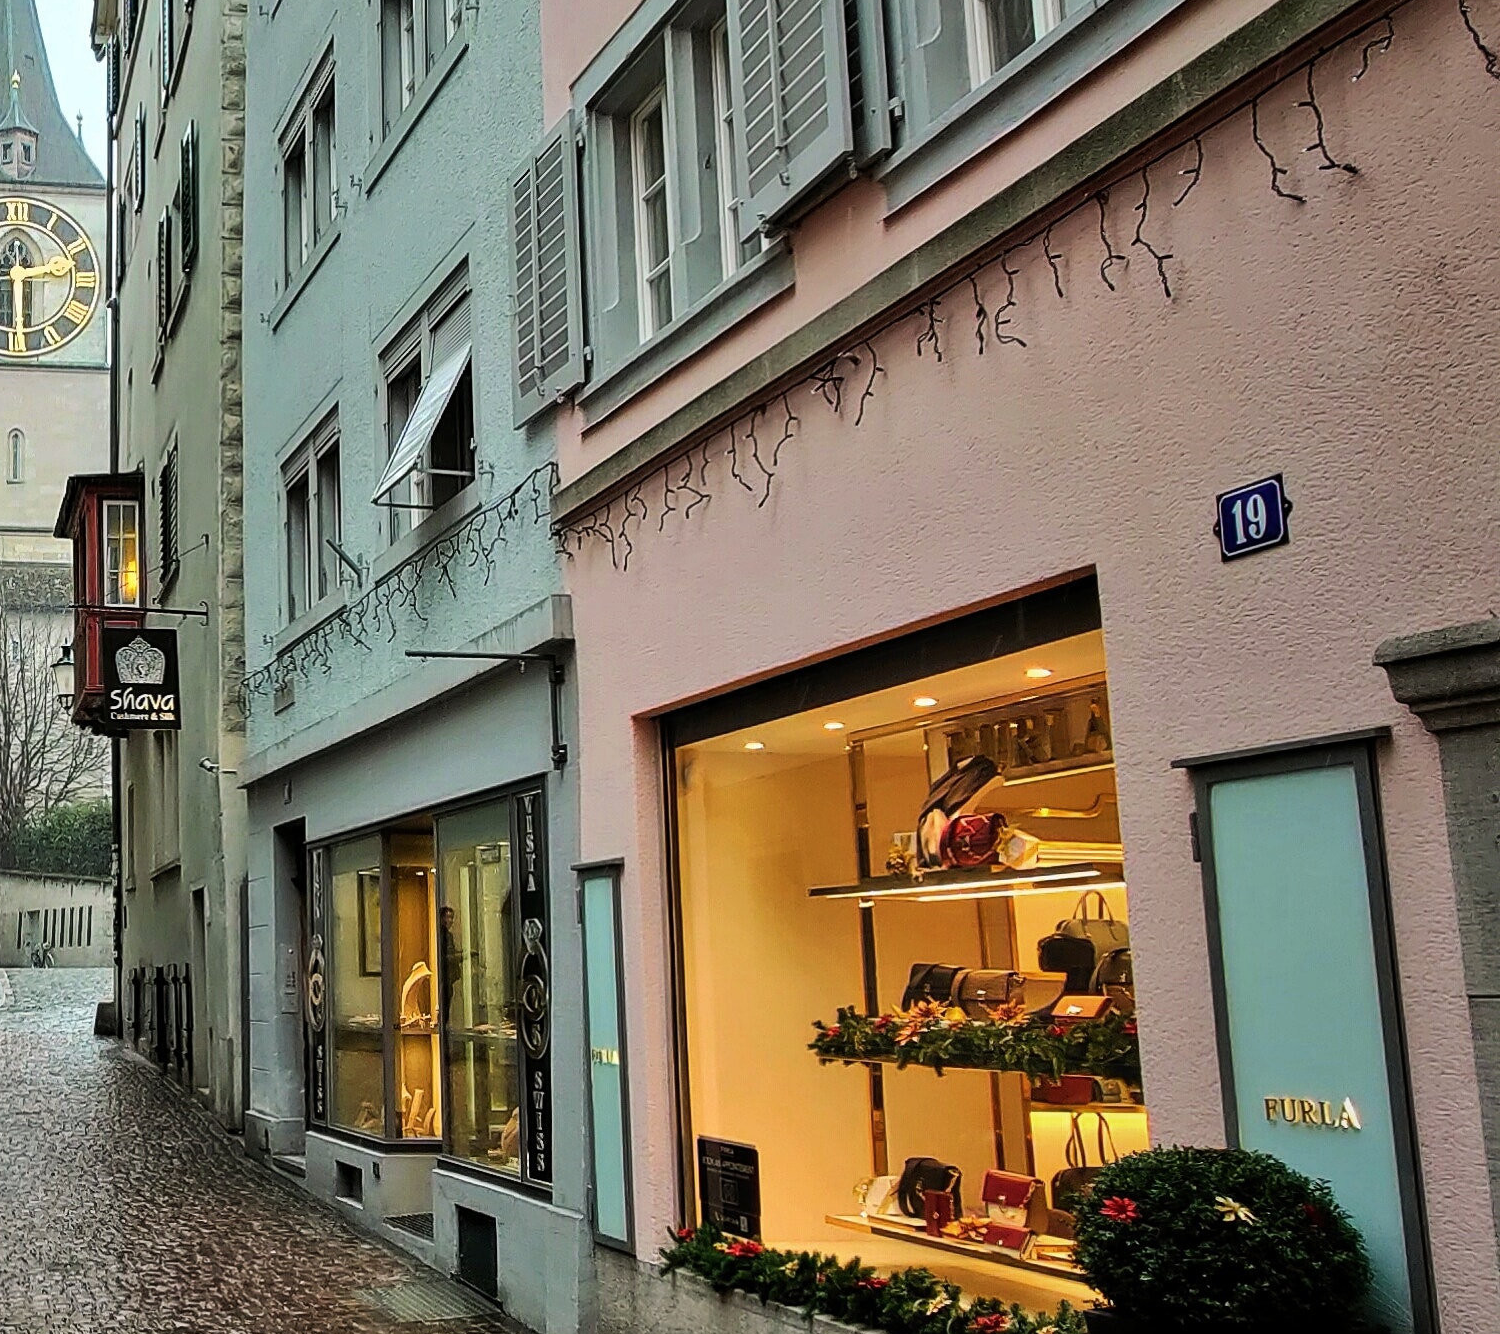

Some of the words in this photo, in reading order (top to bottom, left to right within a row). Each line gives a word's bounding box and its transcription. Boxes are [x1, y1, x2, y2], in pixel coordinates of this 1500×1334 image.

[6, 202, 28, 221] XII
[46, 212, 58, 230] I
[67, 238, 86, 256] II
[76, 272, 95, 287] III
[1232, 494, 1266, 544] 19
[110, 687, 175, 710] Shava
[524, 796, 536, 892] VISTA
[533, 1071, 545, 1171] SWISS
[1264, 1097, 1361, 1130] FURLA
